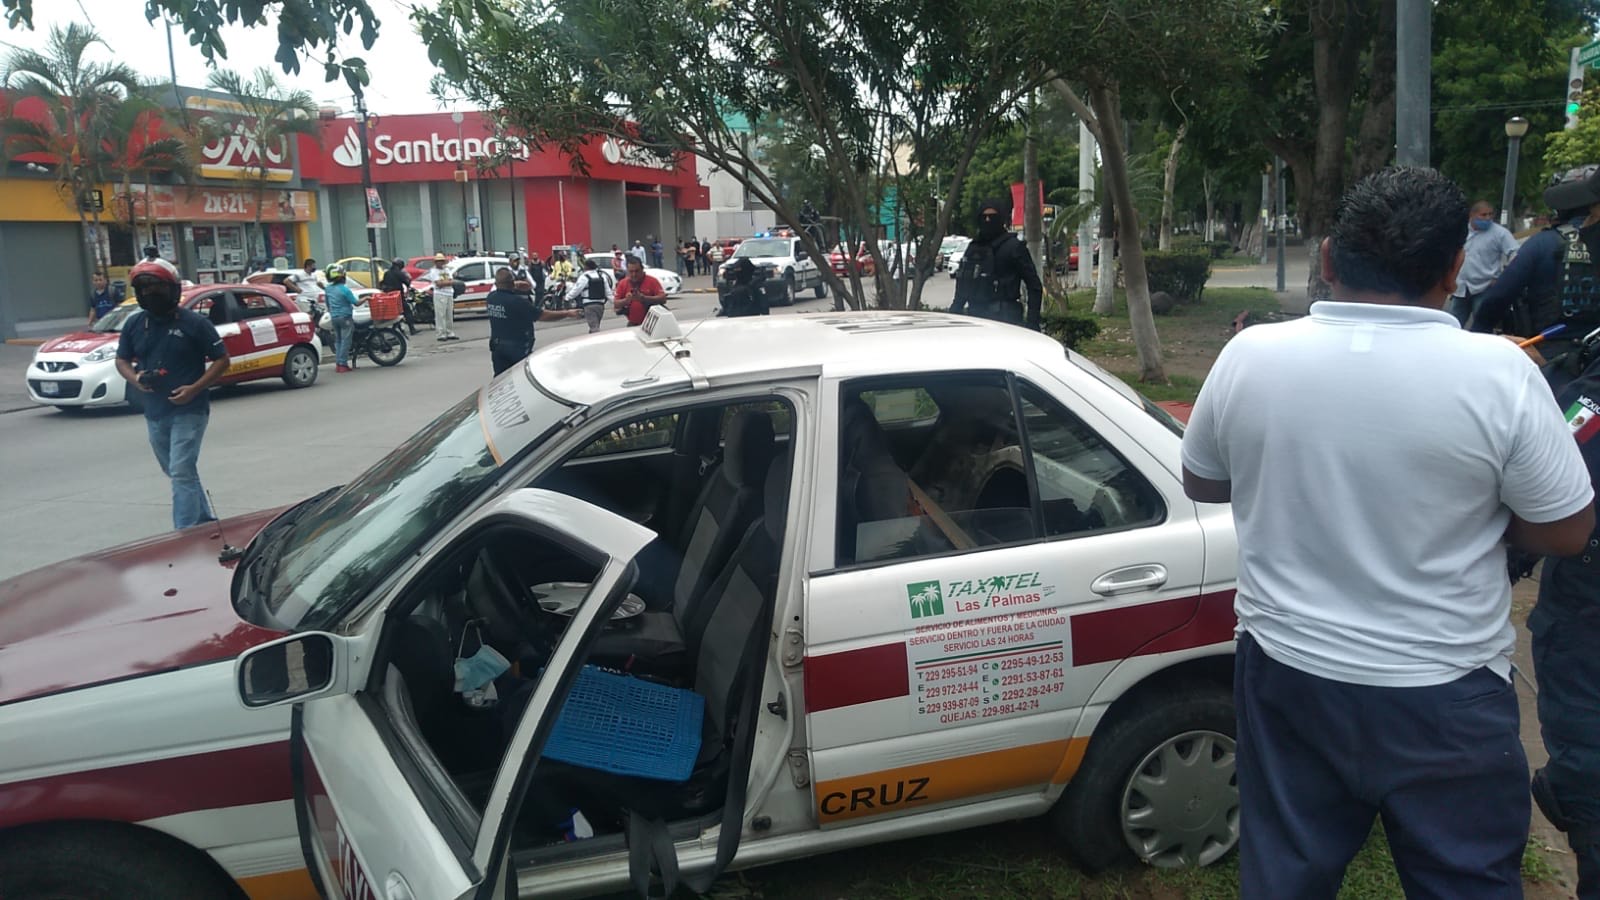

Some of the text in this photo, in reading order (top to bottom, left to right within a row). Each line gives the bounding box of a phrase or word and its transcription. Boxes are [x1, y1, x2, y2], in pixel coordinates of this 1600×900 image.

[955, 592, 1041, 613] Las Palmas
[909, 616, 1066, 646] SERVICIO DENTRO Y FUERA DE LA CIUDAD
[915, 622, 951, 634] SERVICIO
[953, 620, 964, 629] DE
[964, 614, 1009, 628] ALIMENTOS
[1016, 607, 1058, 620] MEDICINAS
[943, 632, 1035, 653] SERVICIO LAS 24 HORAS
[820, 777, 930, 816] CRUZ
